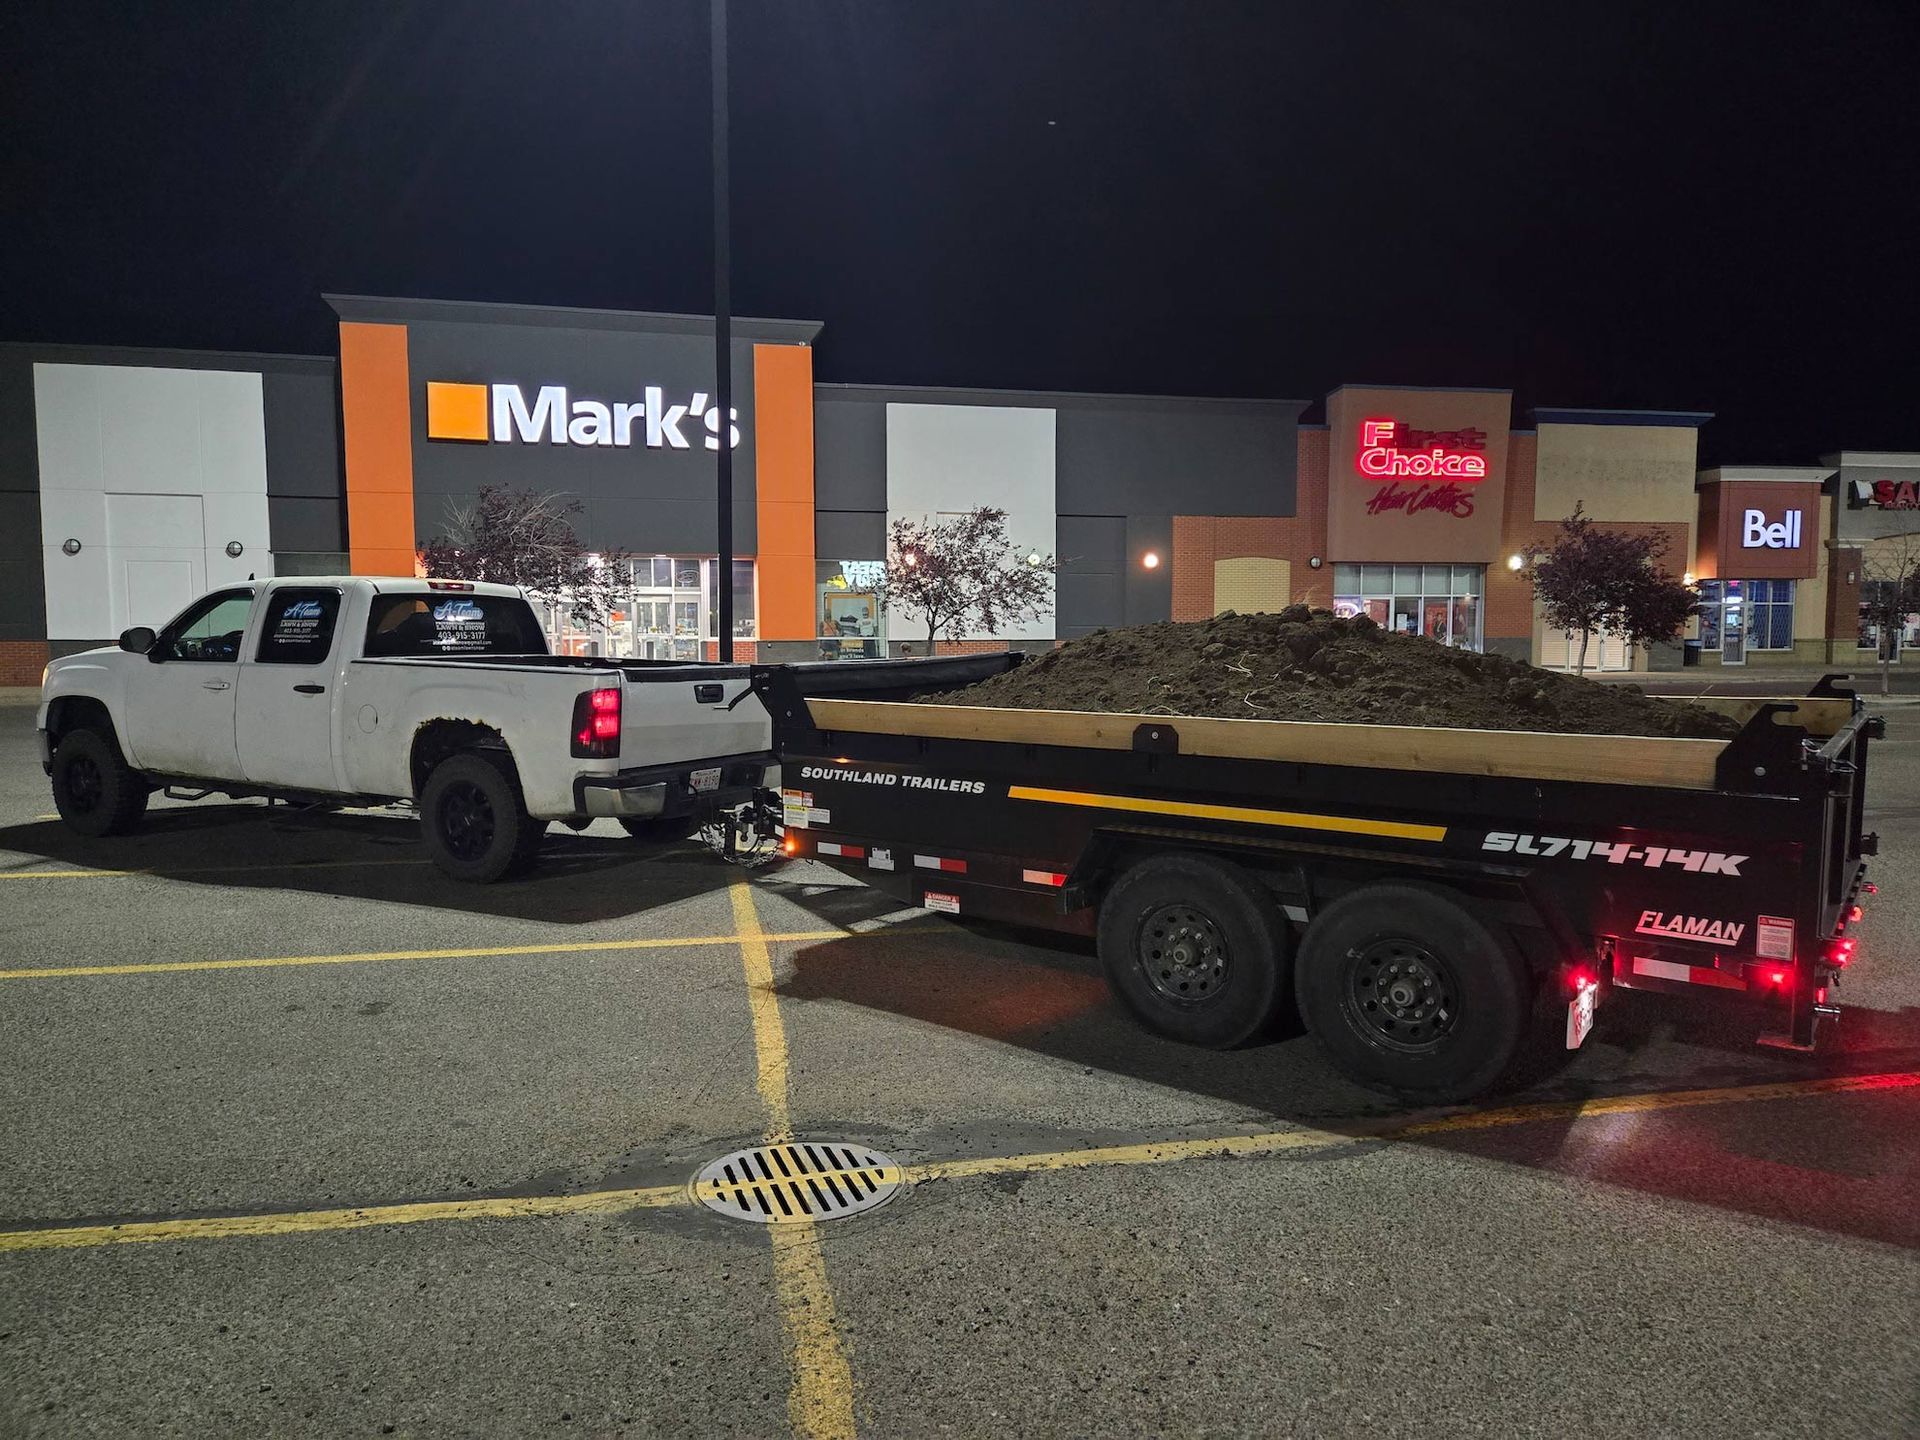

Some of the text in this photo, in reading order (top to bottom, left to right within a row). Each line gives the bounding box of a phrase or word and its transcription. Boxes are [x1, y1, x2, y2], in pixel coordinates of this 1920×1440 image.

[492, 384, 740, 450] Mark's
[1363, 420, 1487, 450] First
[1360, 447, 1486, 477] Choice
[1875, 480, 1920, 503] SA
[1743, 509, 1802, 548] Bell
[434, 600, 484, 619] A-Team
[438, 631, 485, 640] 403-915-3177
[801, 766, 986, 794] SOUTHLAND TRAILERS
[1481, 831, 1750, 877] SL714-14K
[1638, 909, 1746, 942] FLAMAN
